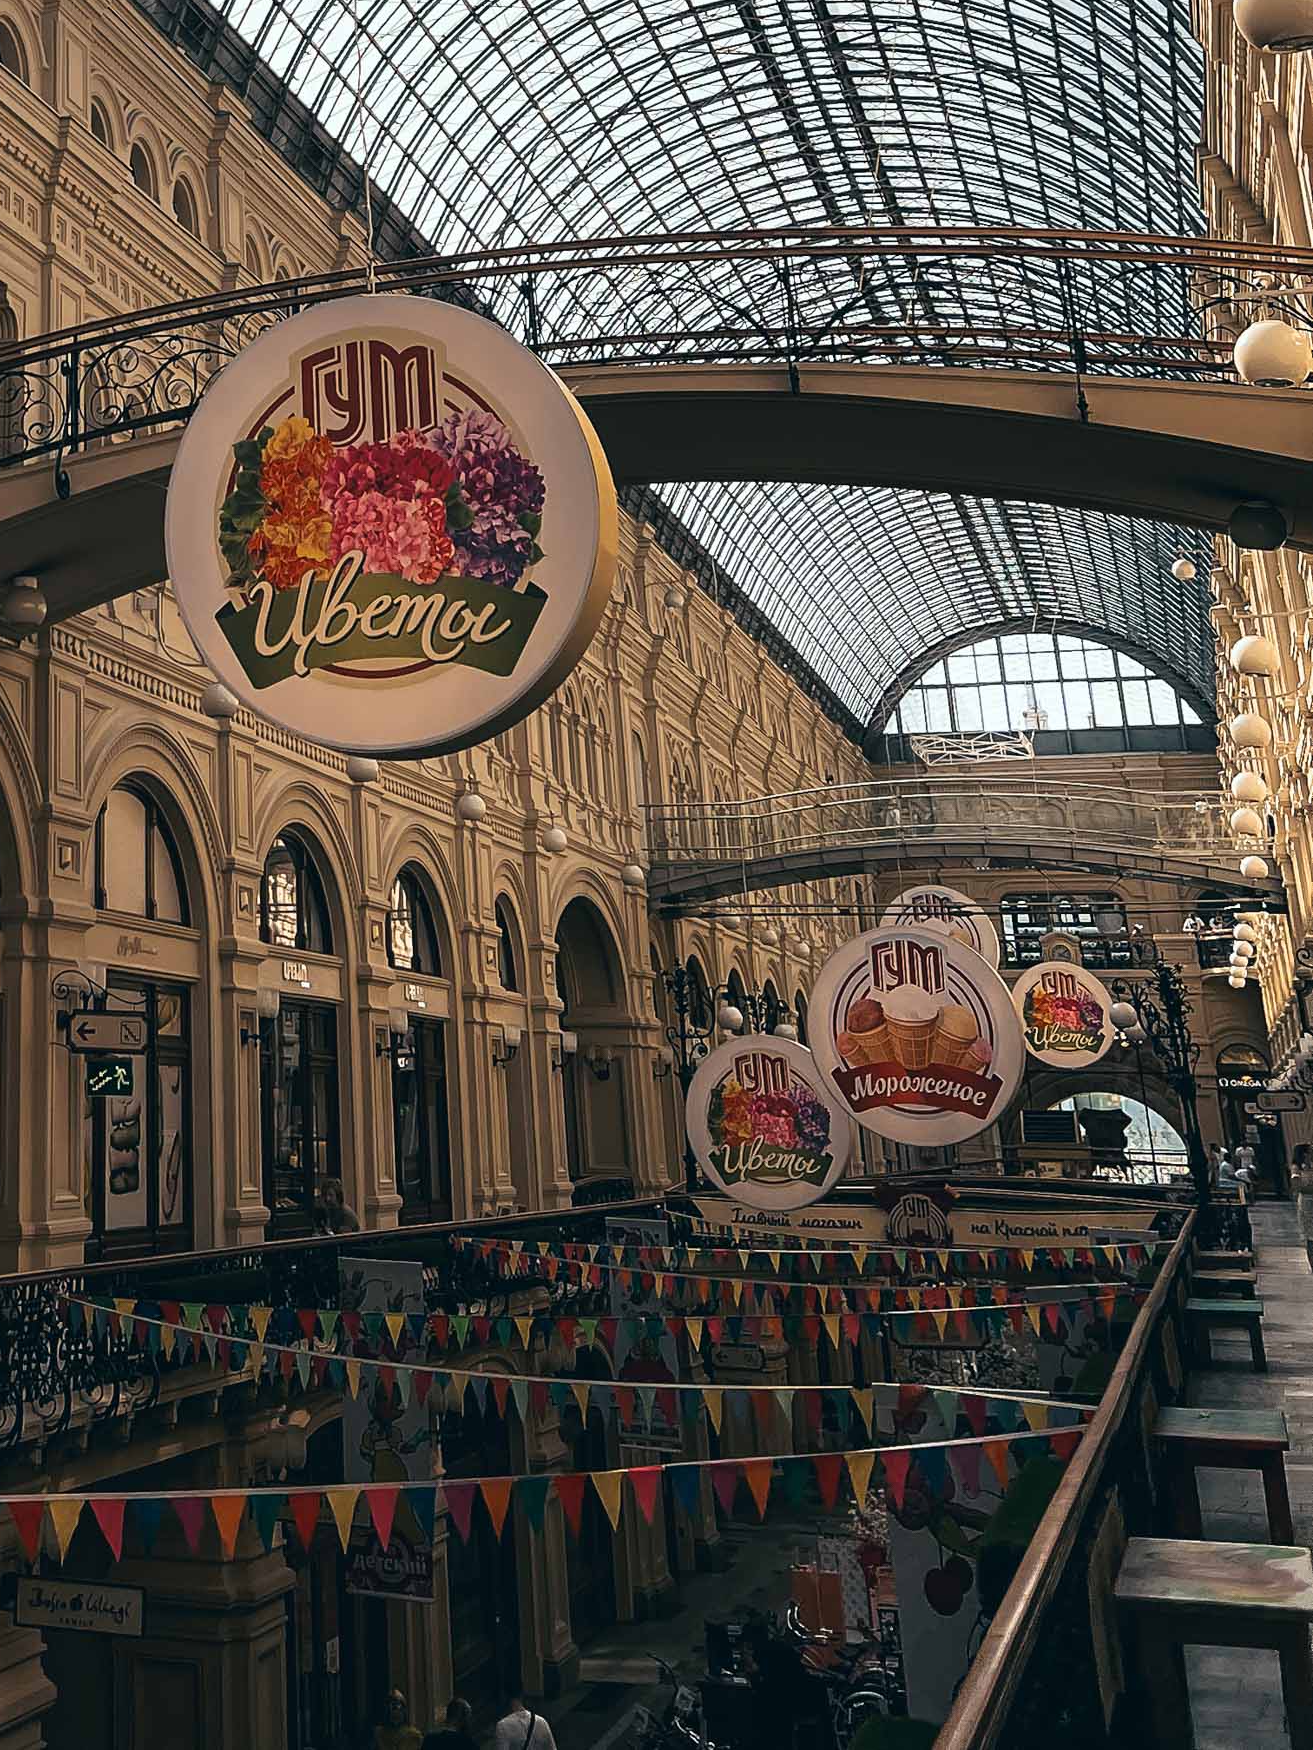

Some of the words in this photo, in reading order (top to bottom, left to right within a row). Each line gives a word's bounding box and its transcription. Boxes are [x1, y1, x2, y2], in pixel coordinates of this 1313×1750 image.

[300, 339, 439, 447] ГУМ
[249, 549, 512, 677] Цветы
[871, 939, 946, 995] ГУМ
[1041, 970, 1077, 999] ГУМ
[1029, 1021, 1098, 1050] Цветы
[734, 1052, 790, 1096] ГУМ
[850, 1073, 988, 1106] Мороженое
[719, 1134, 822, 1182] Цветы
[994, 1219, 1059, 1240] Красной
